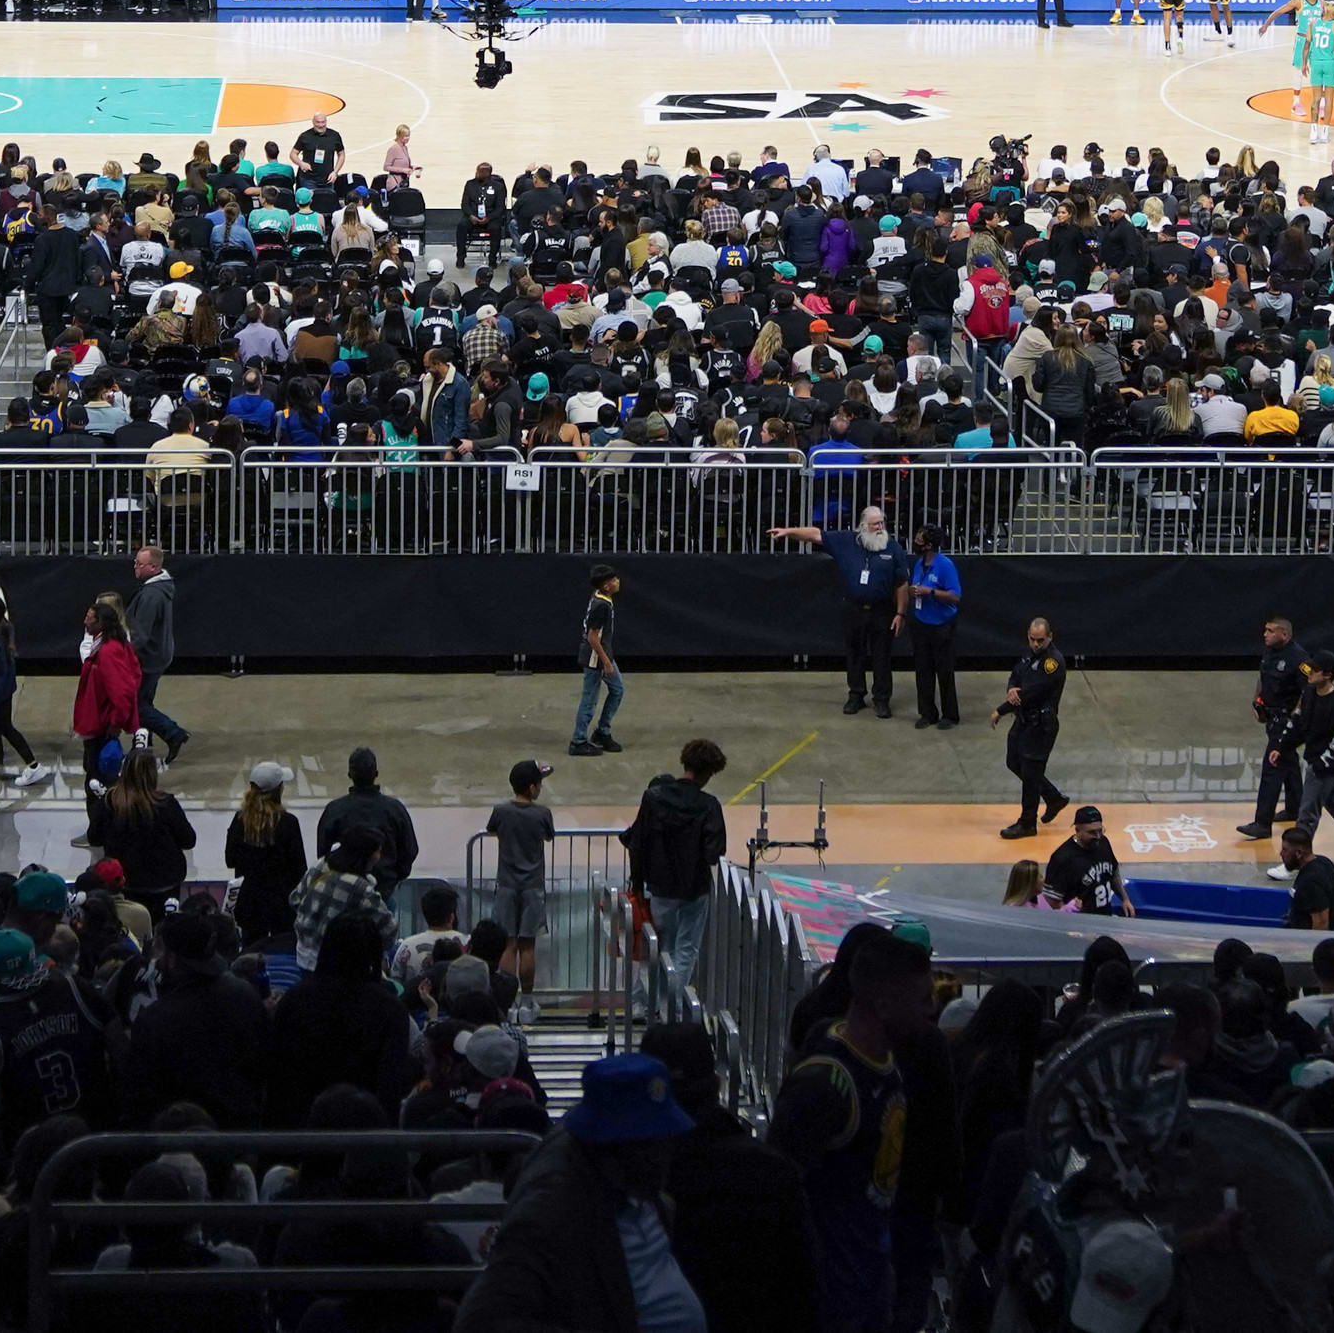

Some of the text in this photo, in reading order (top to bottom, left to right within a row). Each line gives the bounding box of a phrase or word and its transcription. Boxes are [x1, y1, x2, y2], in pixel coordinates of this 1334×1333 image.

[1314, 33, 1328, 48] 10
[656, 92, 931, 121] SA
[432, 326, 443, 346] 1
[513, 469, 534, 478] RS1
[34, 1050, 82, 1115] 3
